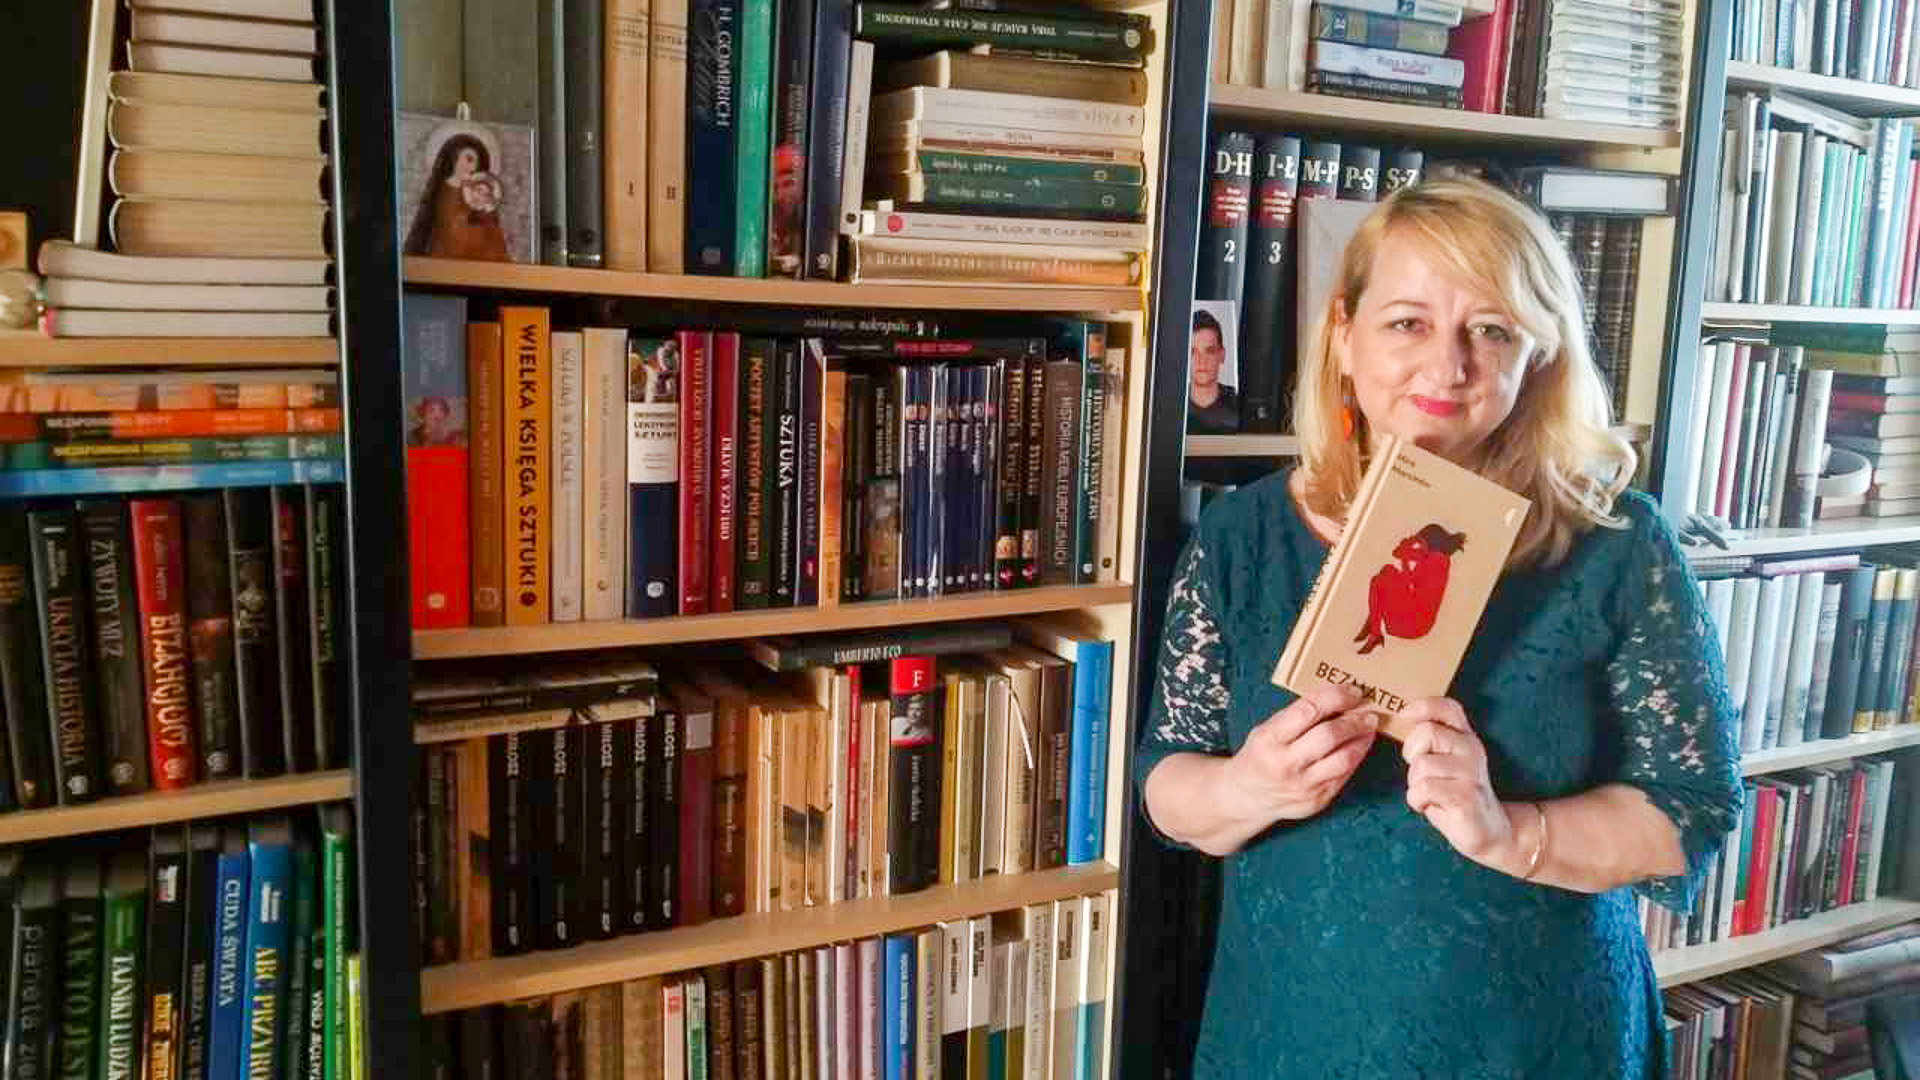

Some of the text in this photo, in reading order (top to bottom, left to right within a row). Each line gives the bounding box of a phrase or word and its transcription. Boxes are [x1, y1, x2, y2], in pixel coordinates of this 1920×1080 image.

[717, 31, 733, 128] GOMBRICH
[1215, 151, 1252, 177] D-H
[1267, 154, 1296, 179] I-Ł
[1303, 159, 1339, 184] M-P
[1344, 166, 1374, 190] P-S
[1223, 240, 1237, 263] 2
[1268, 241, 1282, 264] 3
[516, 324, 537, 588] WIELKA KSIĘGA SZTUKI
[779, 414, 796, 488] SZTUKA
[912, 670, 924, 687] F
[222, 878, 241, 931] CUDA
[21, 924, 44, 1031] planeta
[110, 953, 136, 1020] TAJNIKI
